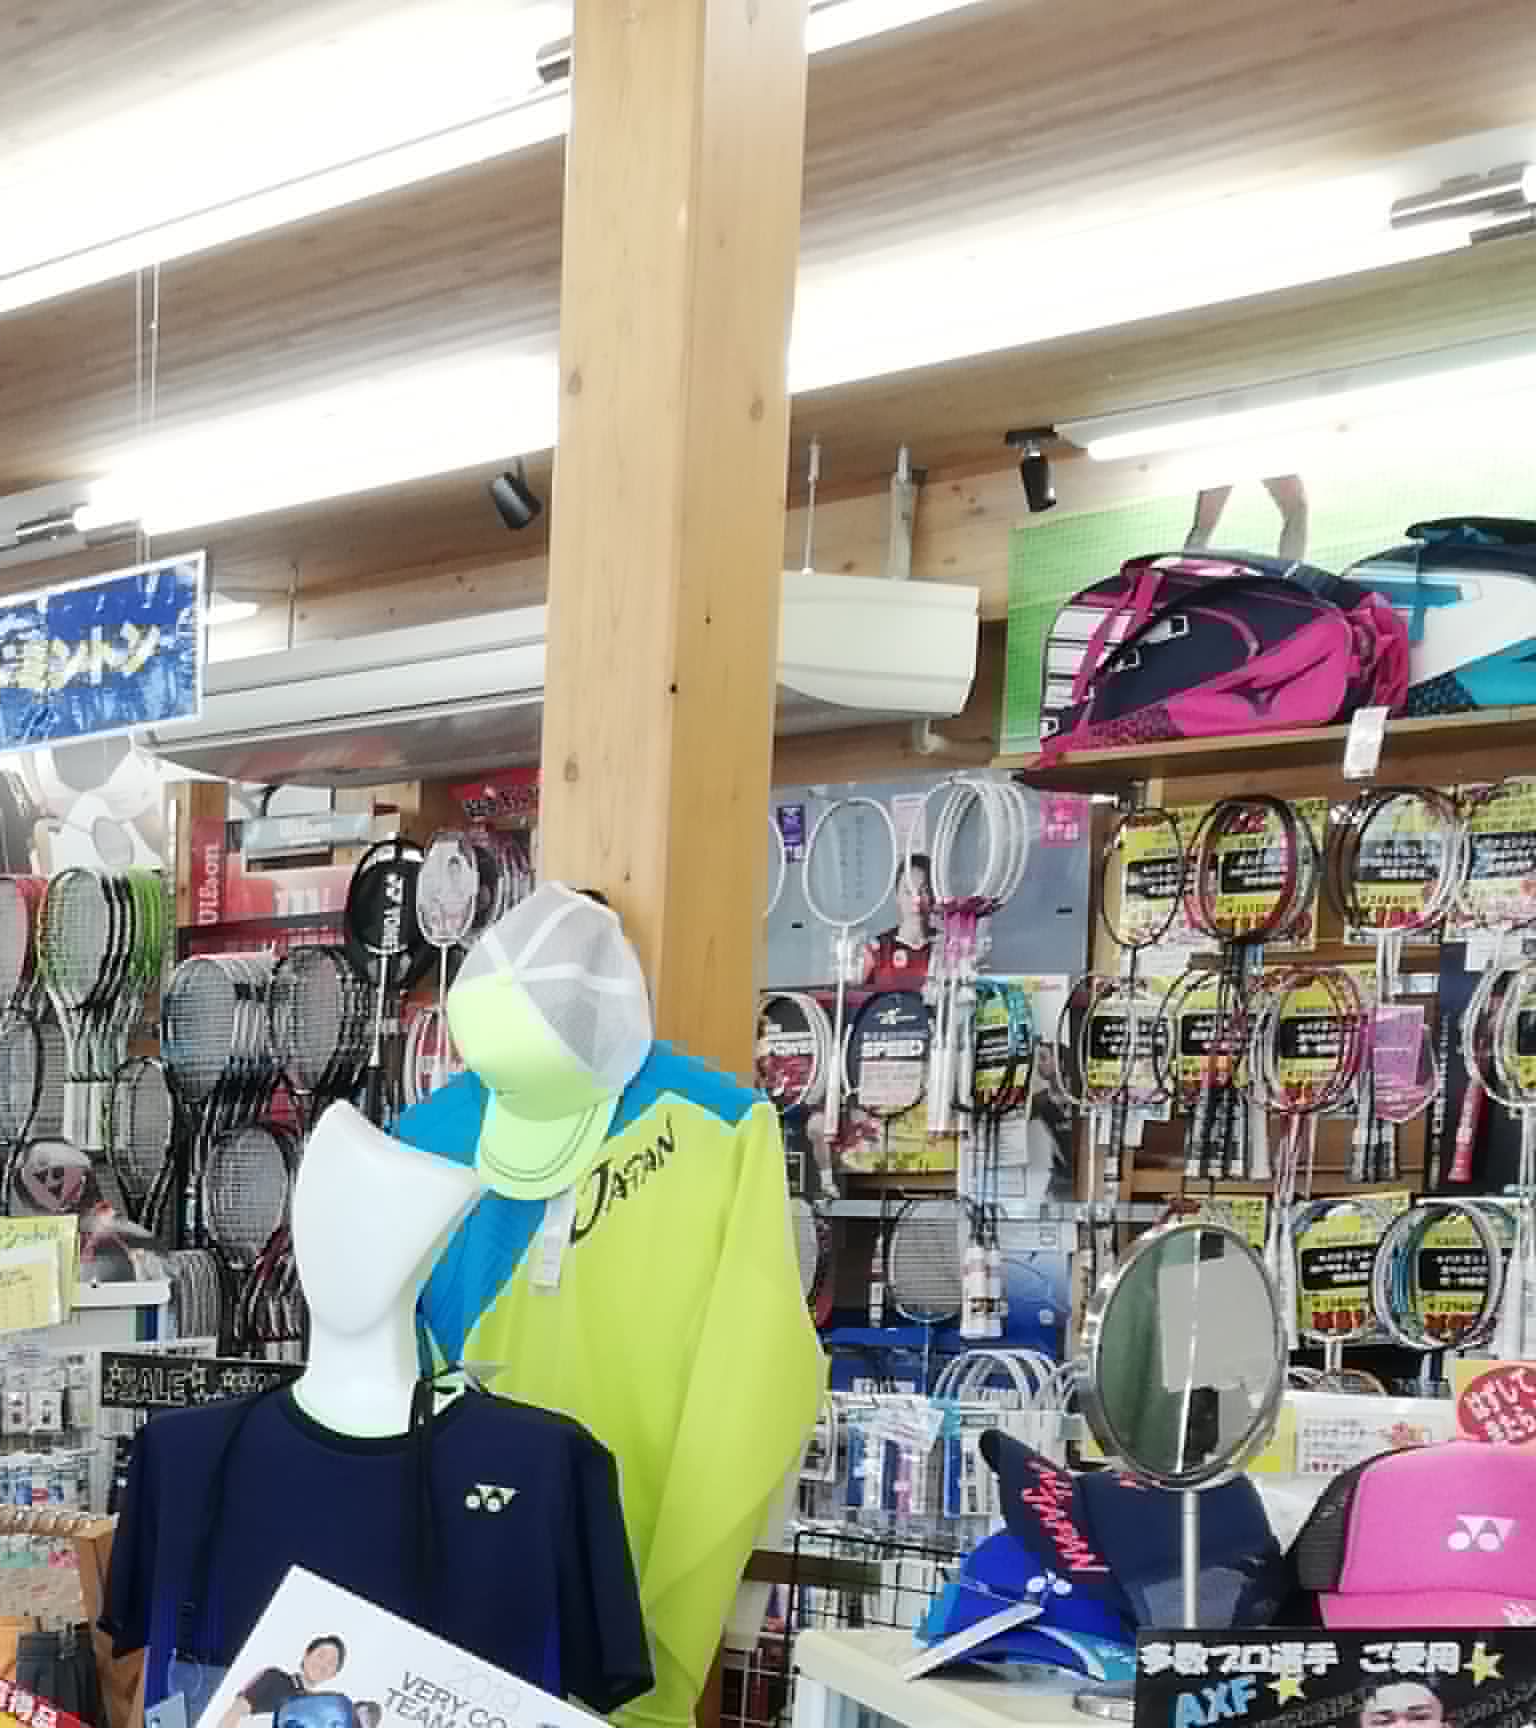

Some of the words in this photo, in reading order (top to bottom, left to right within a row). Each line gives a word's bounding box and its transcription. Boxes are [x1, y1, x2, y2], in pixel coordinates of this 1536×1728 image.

[861, 1038, 924, 1058] SPEED
[569, 1112, 676, 1245] JAPAN
[1139, 1640, 1339, 1678] 多数プロ選手
[1359, 1640, 1463, 1676] ご愛用
[399, 1670, 470, 1722] VERY
